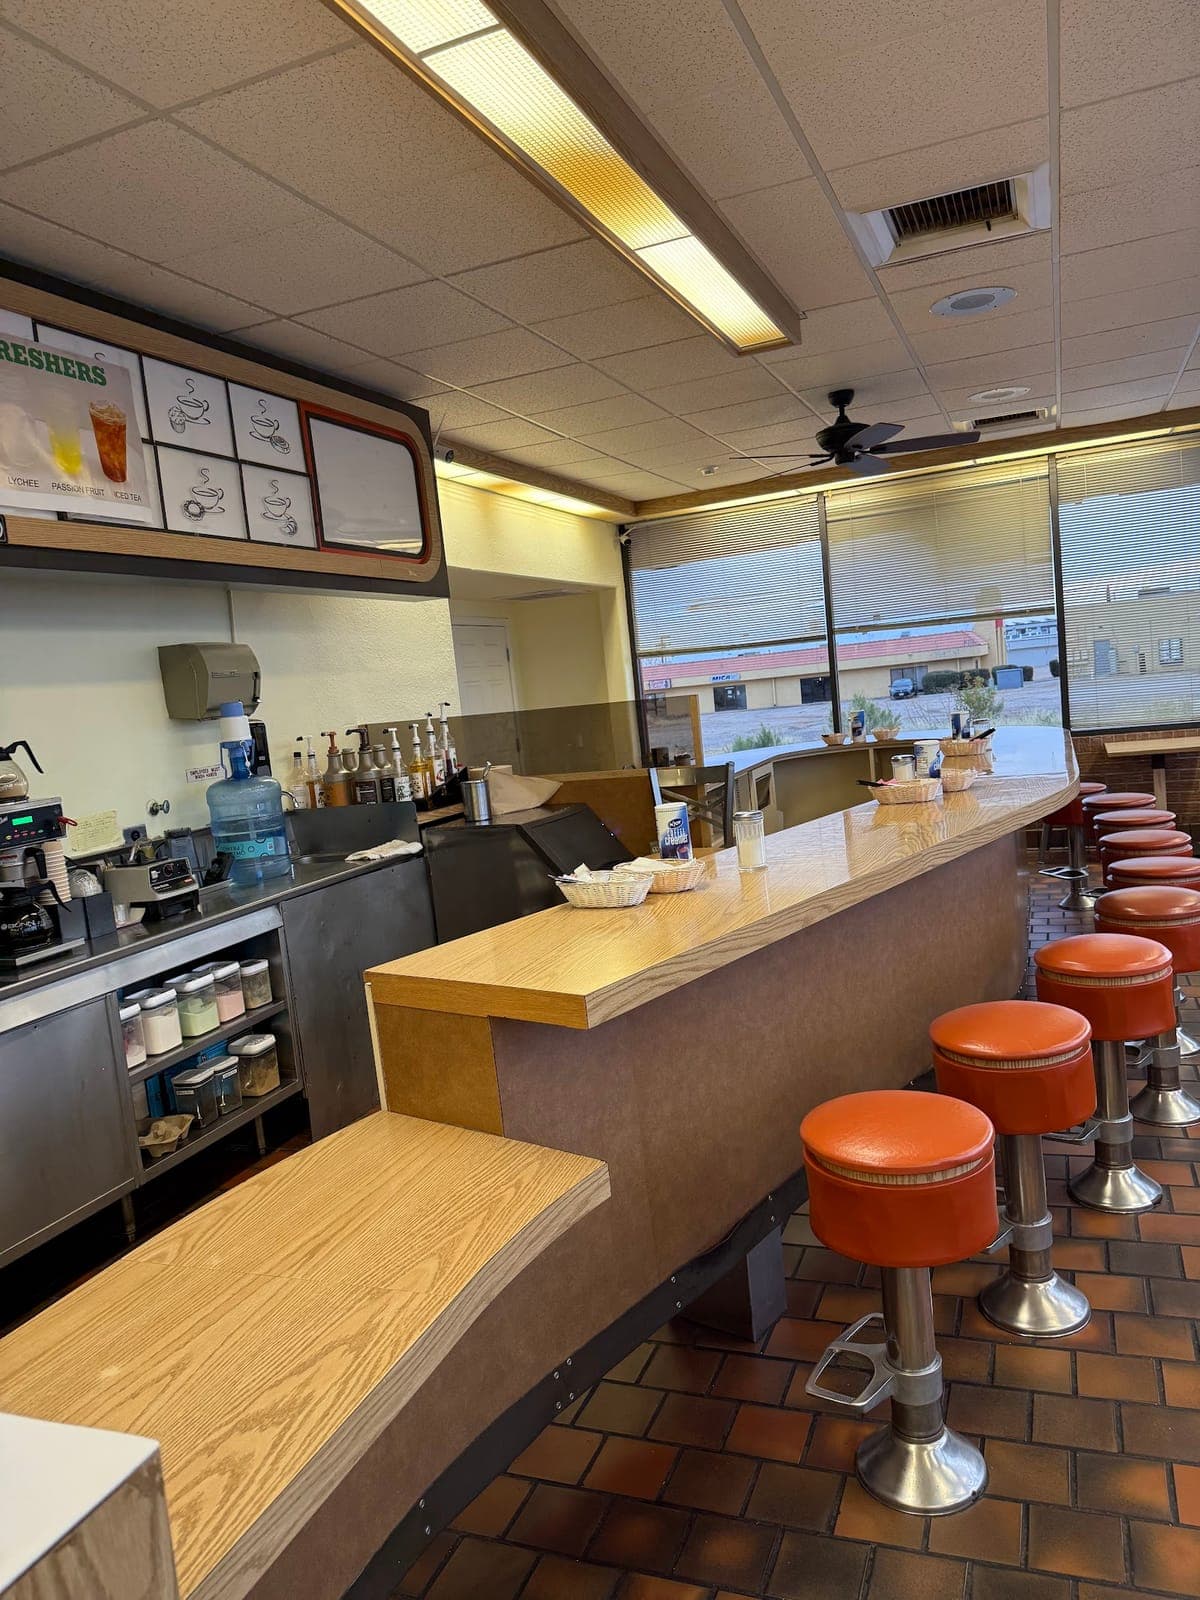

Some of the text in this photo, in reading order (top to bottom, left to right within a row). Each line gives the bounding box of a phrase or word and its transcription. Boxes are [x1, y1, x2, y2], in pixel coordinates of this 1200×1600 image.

[7, 476, 40, 488] LYCHEE
[51, 481, 105, 497] PASSION FRUIT
[113, 490, 142, 502] ICED TEA
